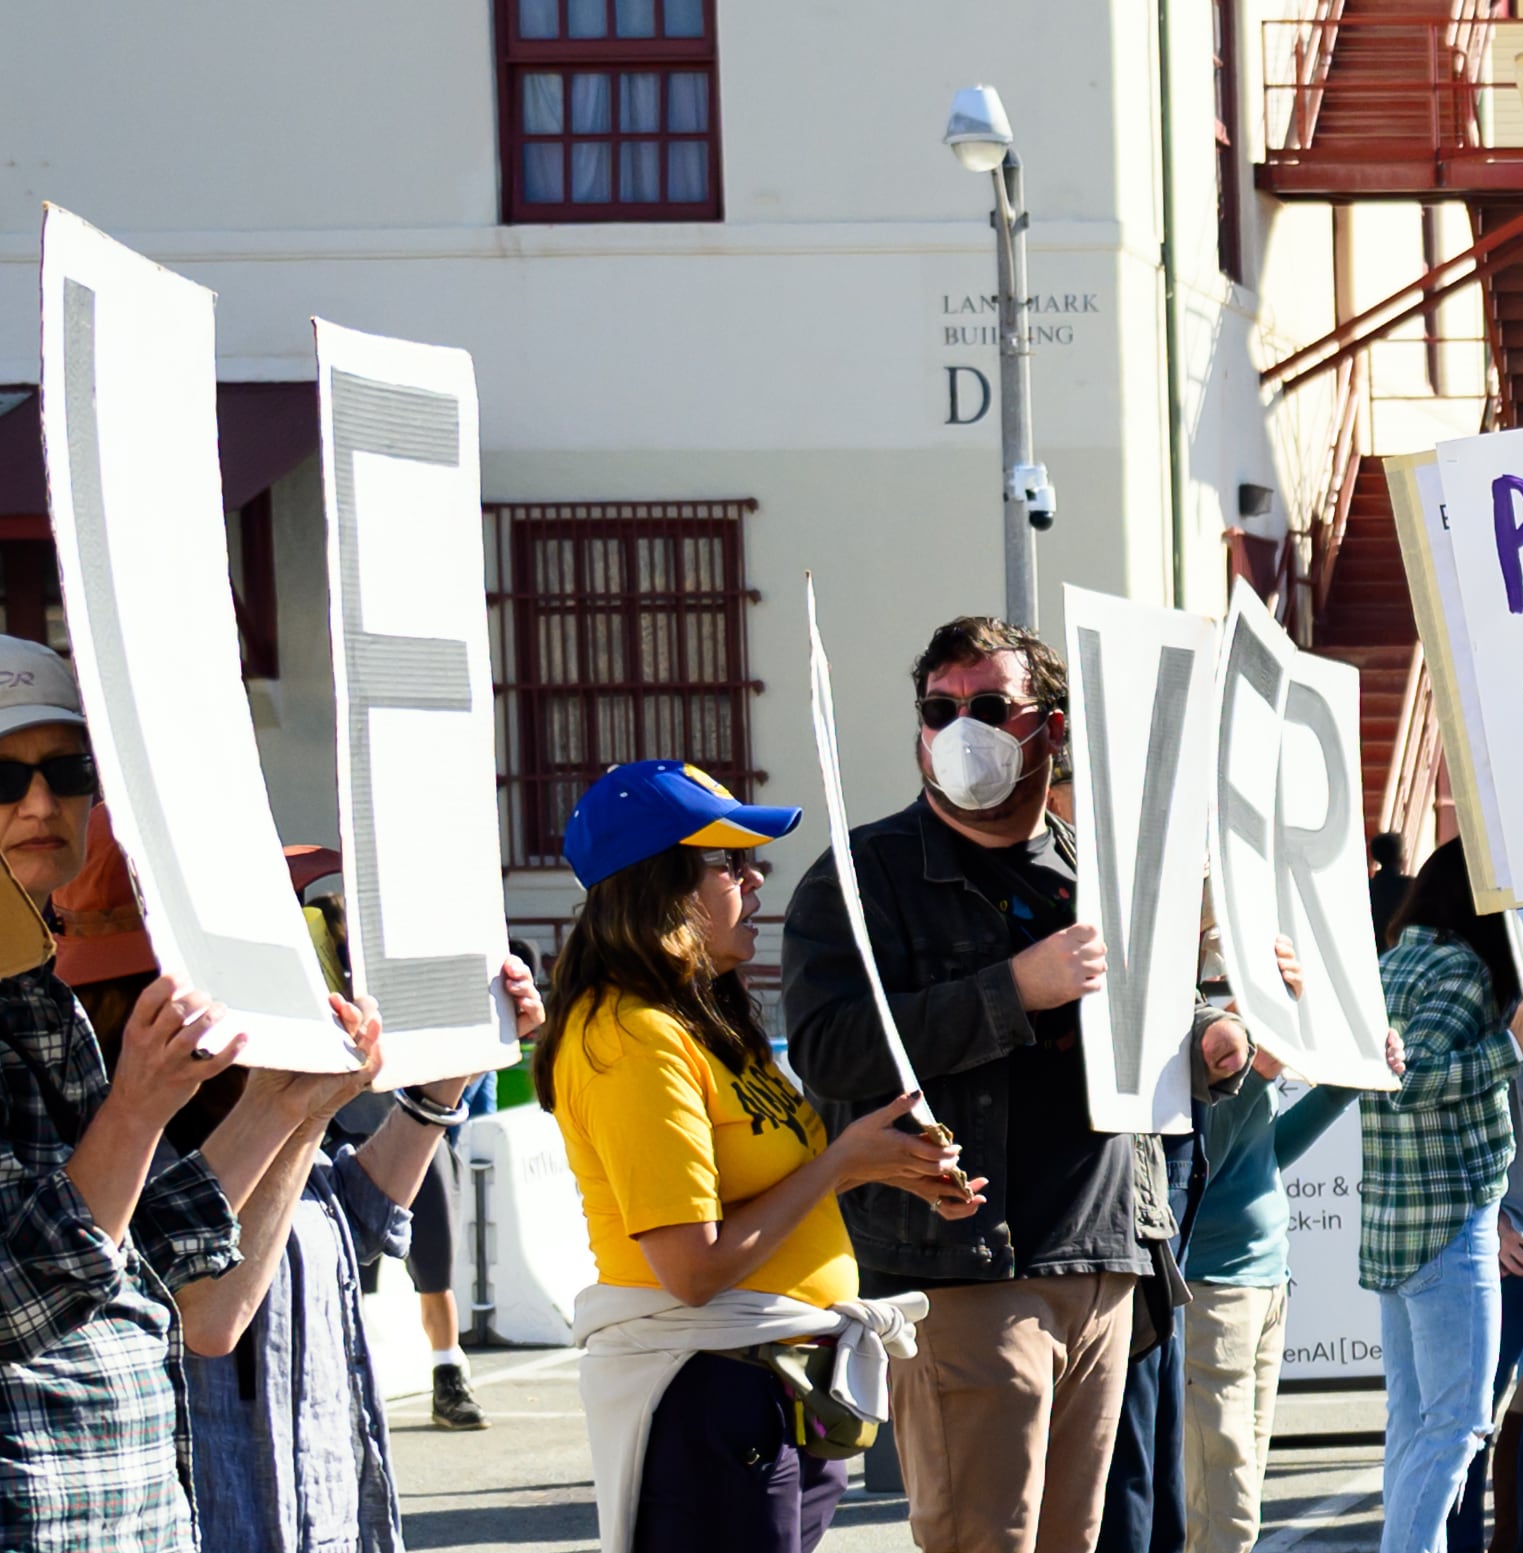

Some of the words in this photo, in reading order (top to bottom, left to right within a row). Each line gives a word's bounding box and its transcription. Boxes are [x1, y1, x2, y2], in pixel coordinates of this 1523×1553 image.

[943, 294, 1099, 314] LANMARK
[944, 326, 1074, 346] BUILING
[944, 366, 991, 424] D
[330, 366, 491, 1032] E
[1077, 626, 1196, 1095] V
[1274, 679, 1385, 1061] R
[1286, 1177, 1326, 1198] dor
[1333, 1176, 1349, 1197] &
[1287, 1209, 1342, 1231] ck-in
